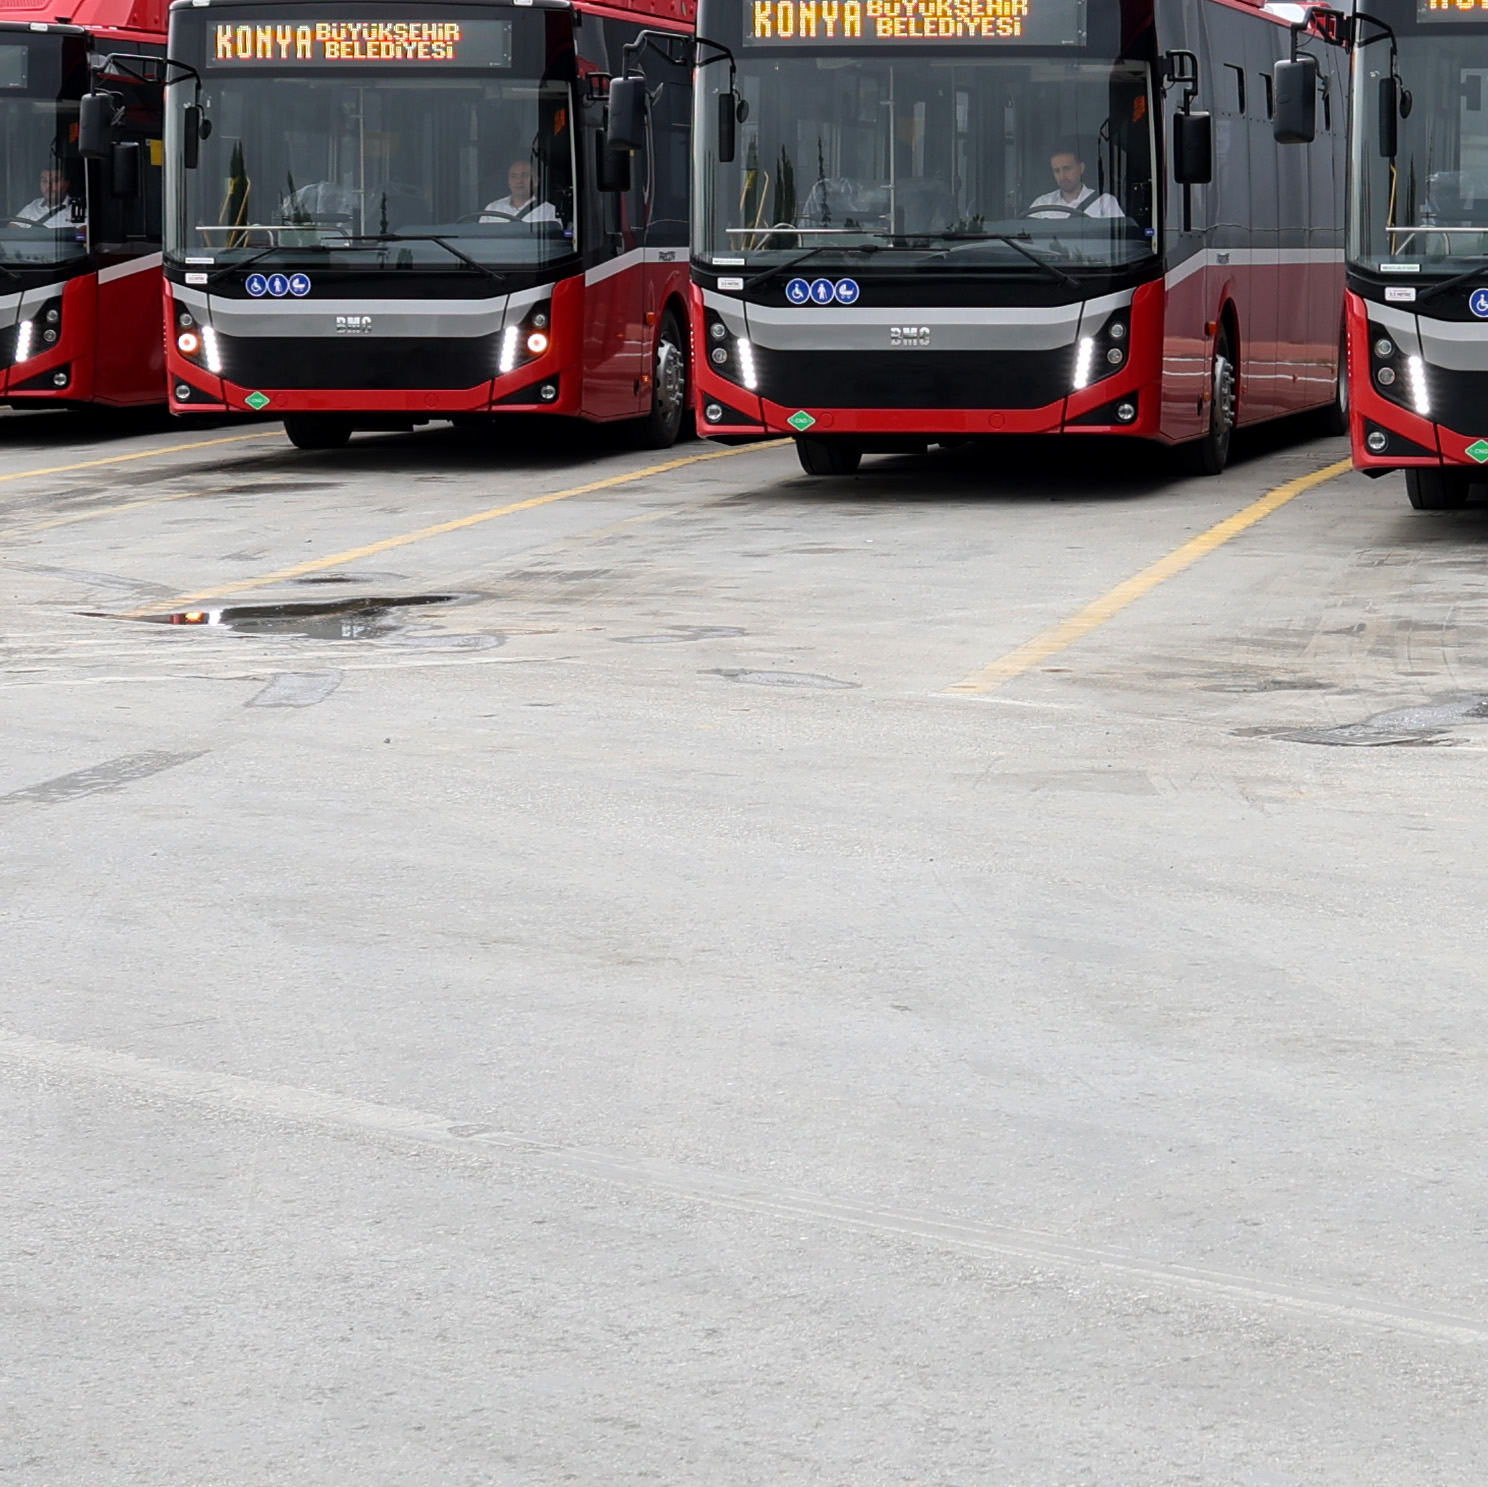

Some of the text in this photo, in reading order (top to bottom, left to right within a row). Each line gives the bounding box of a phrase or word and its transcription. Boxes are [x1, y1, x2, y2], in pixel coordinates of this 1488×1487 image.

[754, 0, 862, 37] KONYA
[876, 16, 1022, 37] BELEDİYESİ
[216, 25, 313, 59] KONYA
[315, 23, 460, 41] BÜYÜKŞEHİR
[325, 41, 453, 59] BELEDİYESİ
[890, 326, 930, 346] BMC
